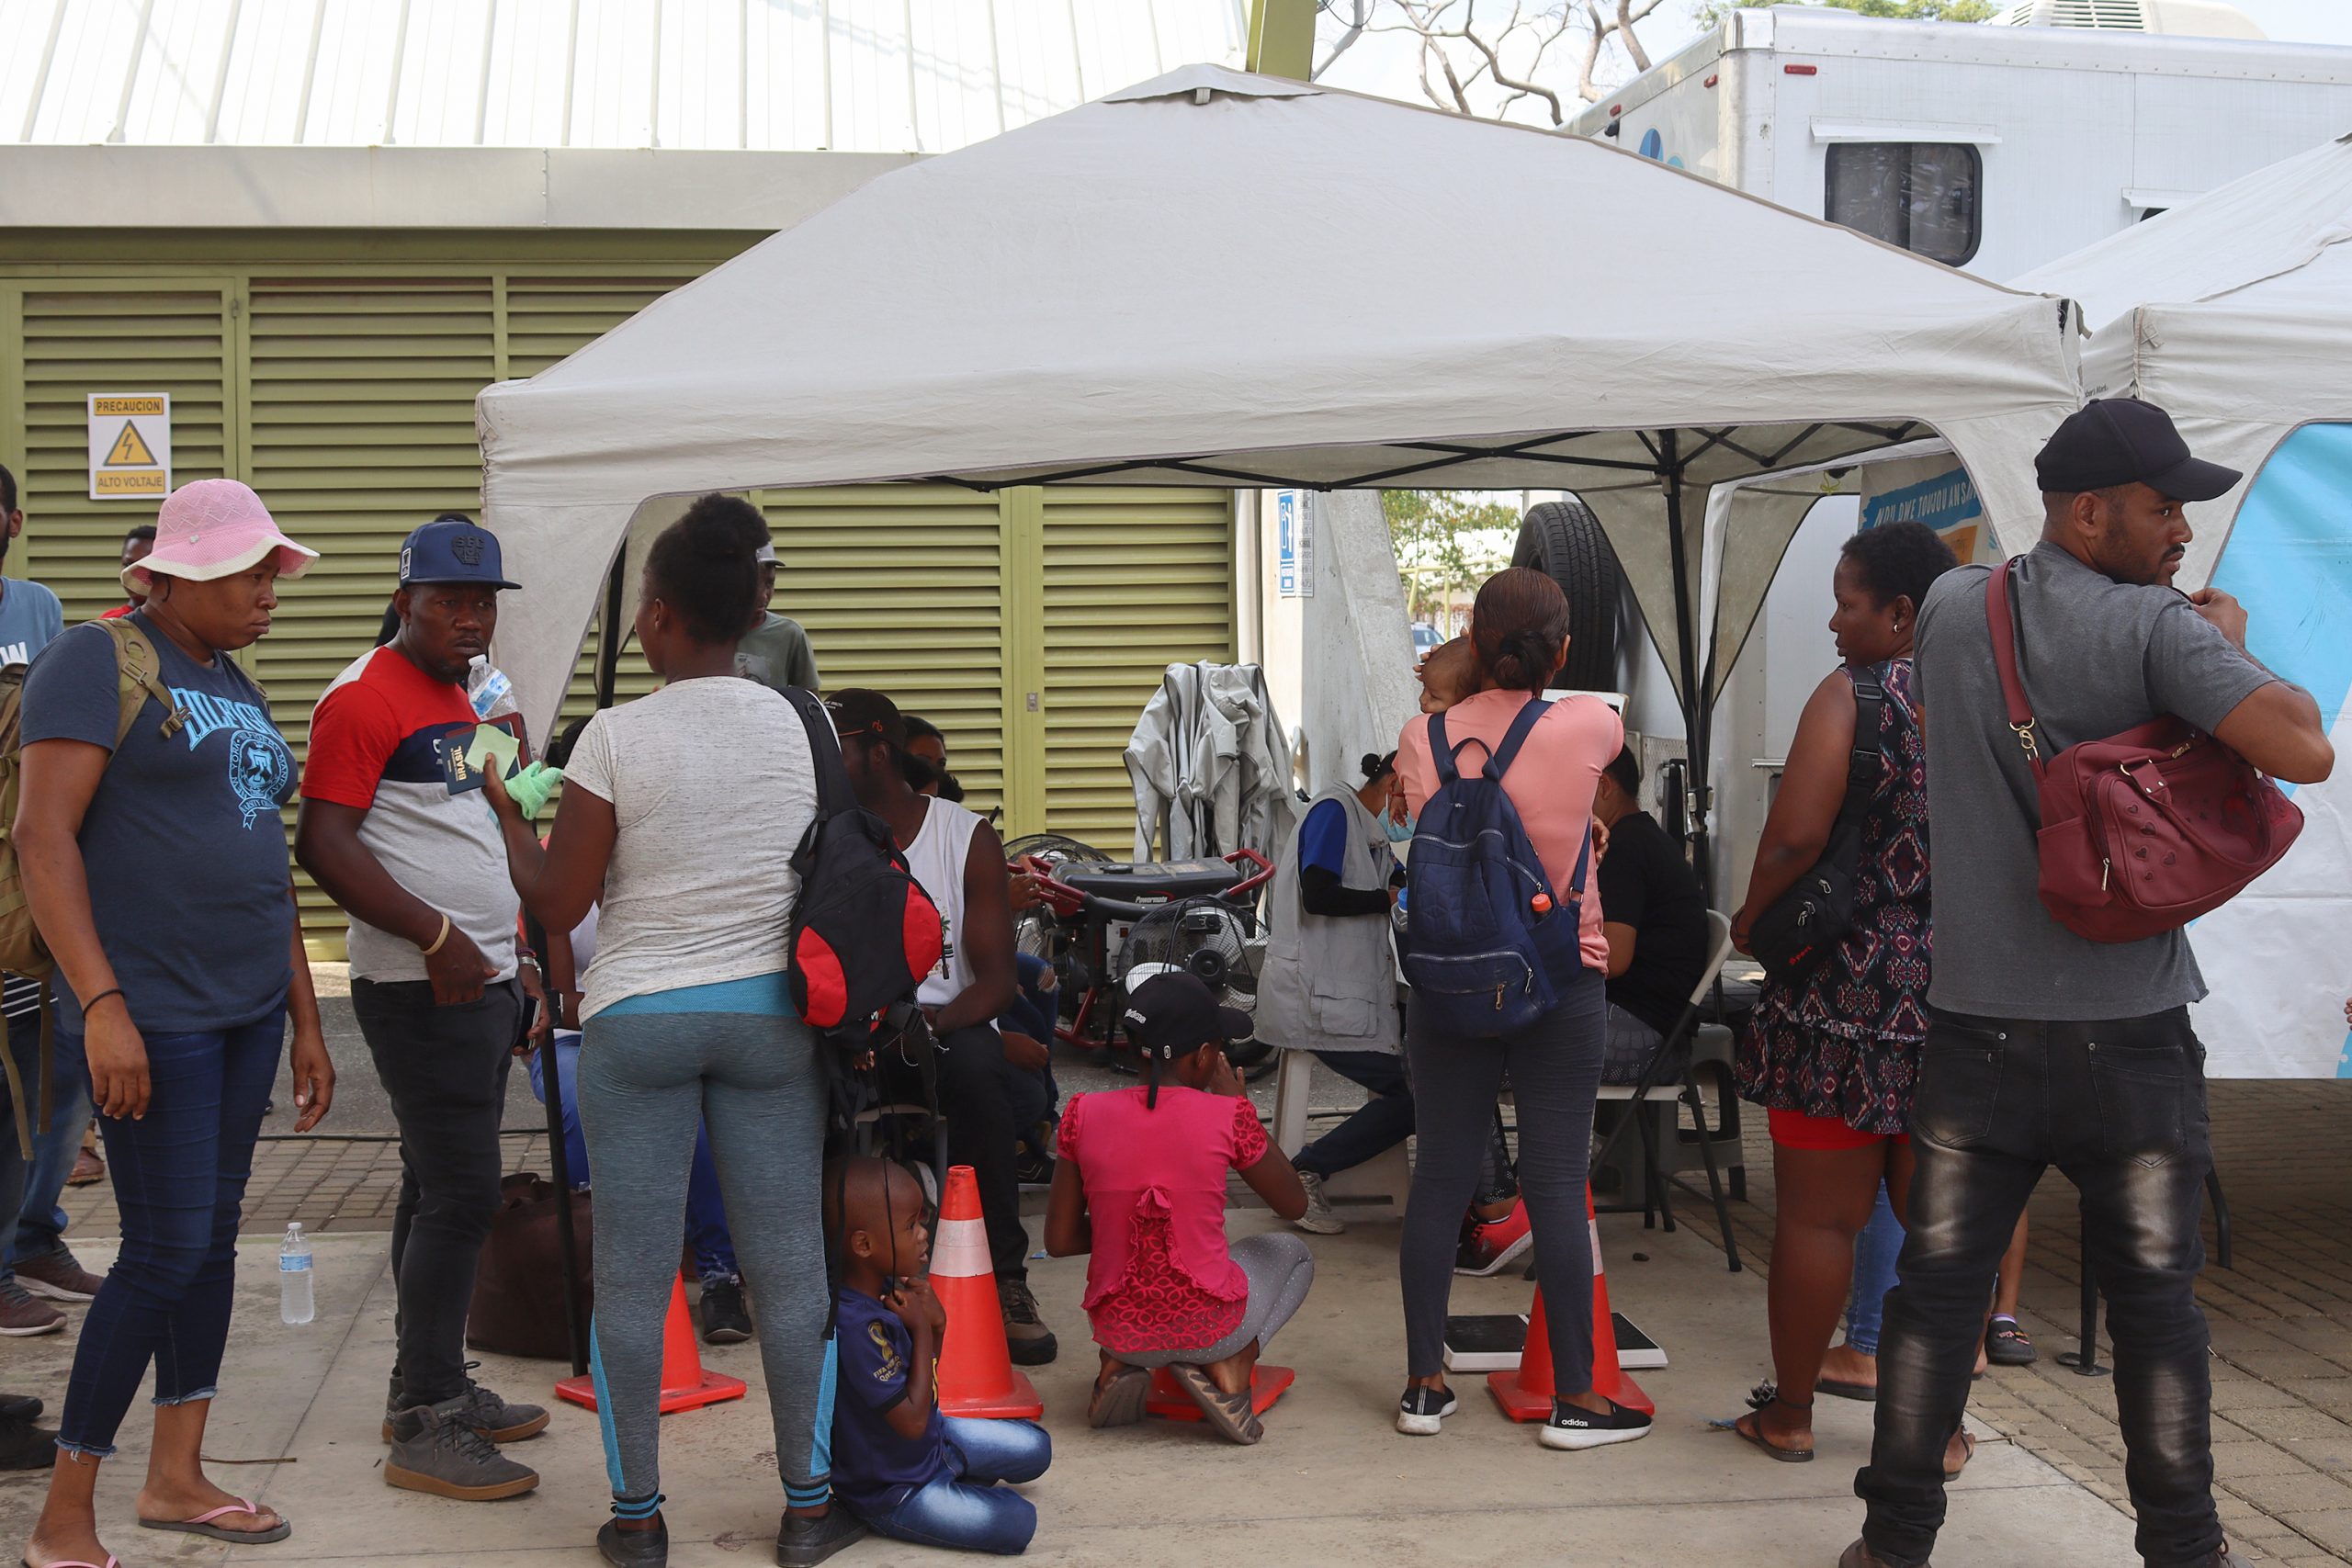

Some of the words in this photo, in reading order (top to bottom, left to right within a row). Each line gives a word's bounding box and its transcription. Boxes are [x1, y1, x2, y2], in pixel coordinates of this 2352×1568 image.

[96, 400, 161, 412] PRECAUCION
[97, 477, 121, 488] ALTO
[124, 476, 163, 487] VOLTAJE
[453, 745, 468, 781] BRASIL
[1561, 1418, 1589, 1427] adidas
